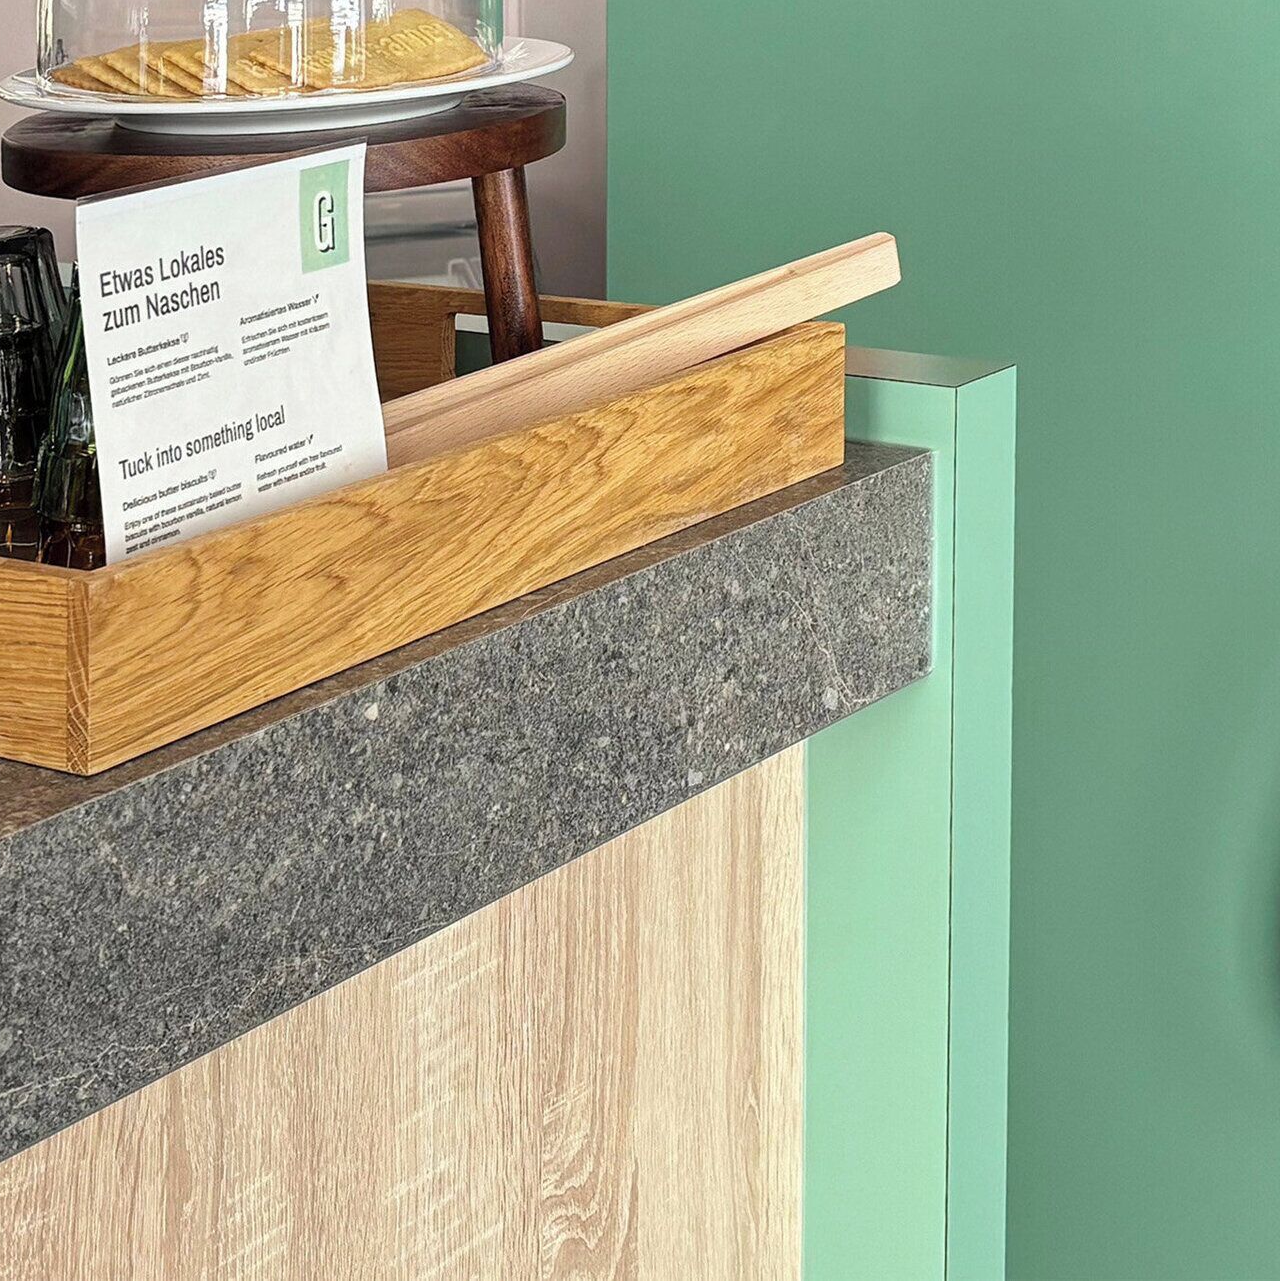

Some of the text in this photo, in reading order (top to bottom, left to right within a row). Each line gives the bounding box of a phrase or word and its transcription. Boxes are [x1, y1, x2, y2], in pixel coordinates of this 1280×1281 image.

[313, 190, 336, 252] G
[99, 245, 225, 297] Etwas Lokales
[102, 281, 221, 332] zum Naschen
[118, 404, 285, 480] Tuck into something local
[255, 440, 306, 464] Flavoured water
[123, 475, 208, 511] Delicious butter biscuits
